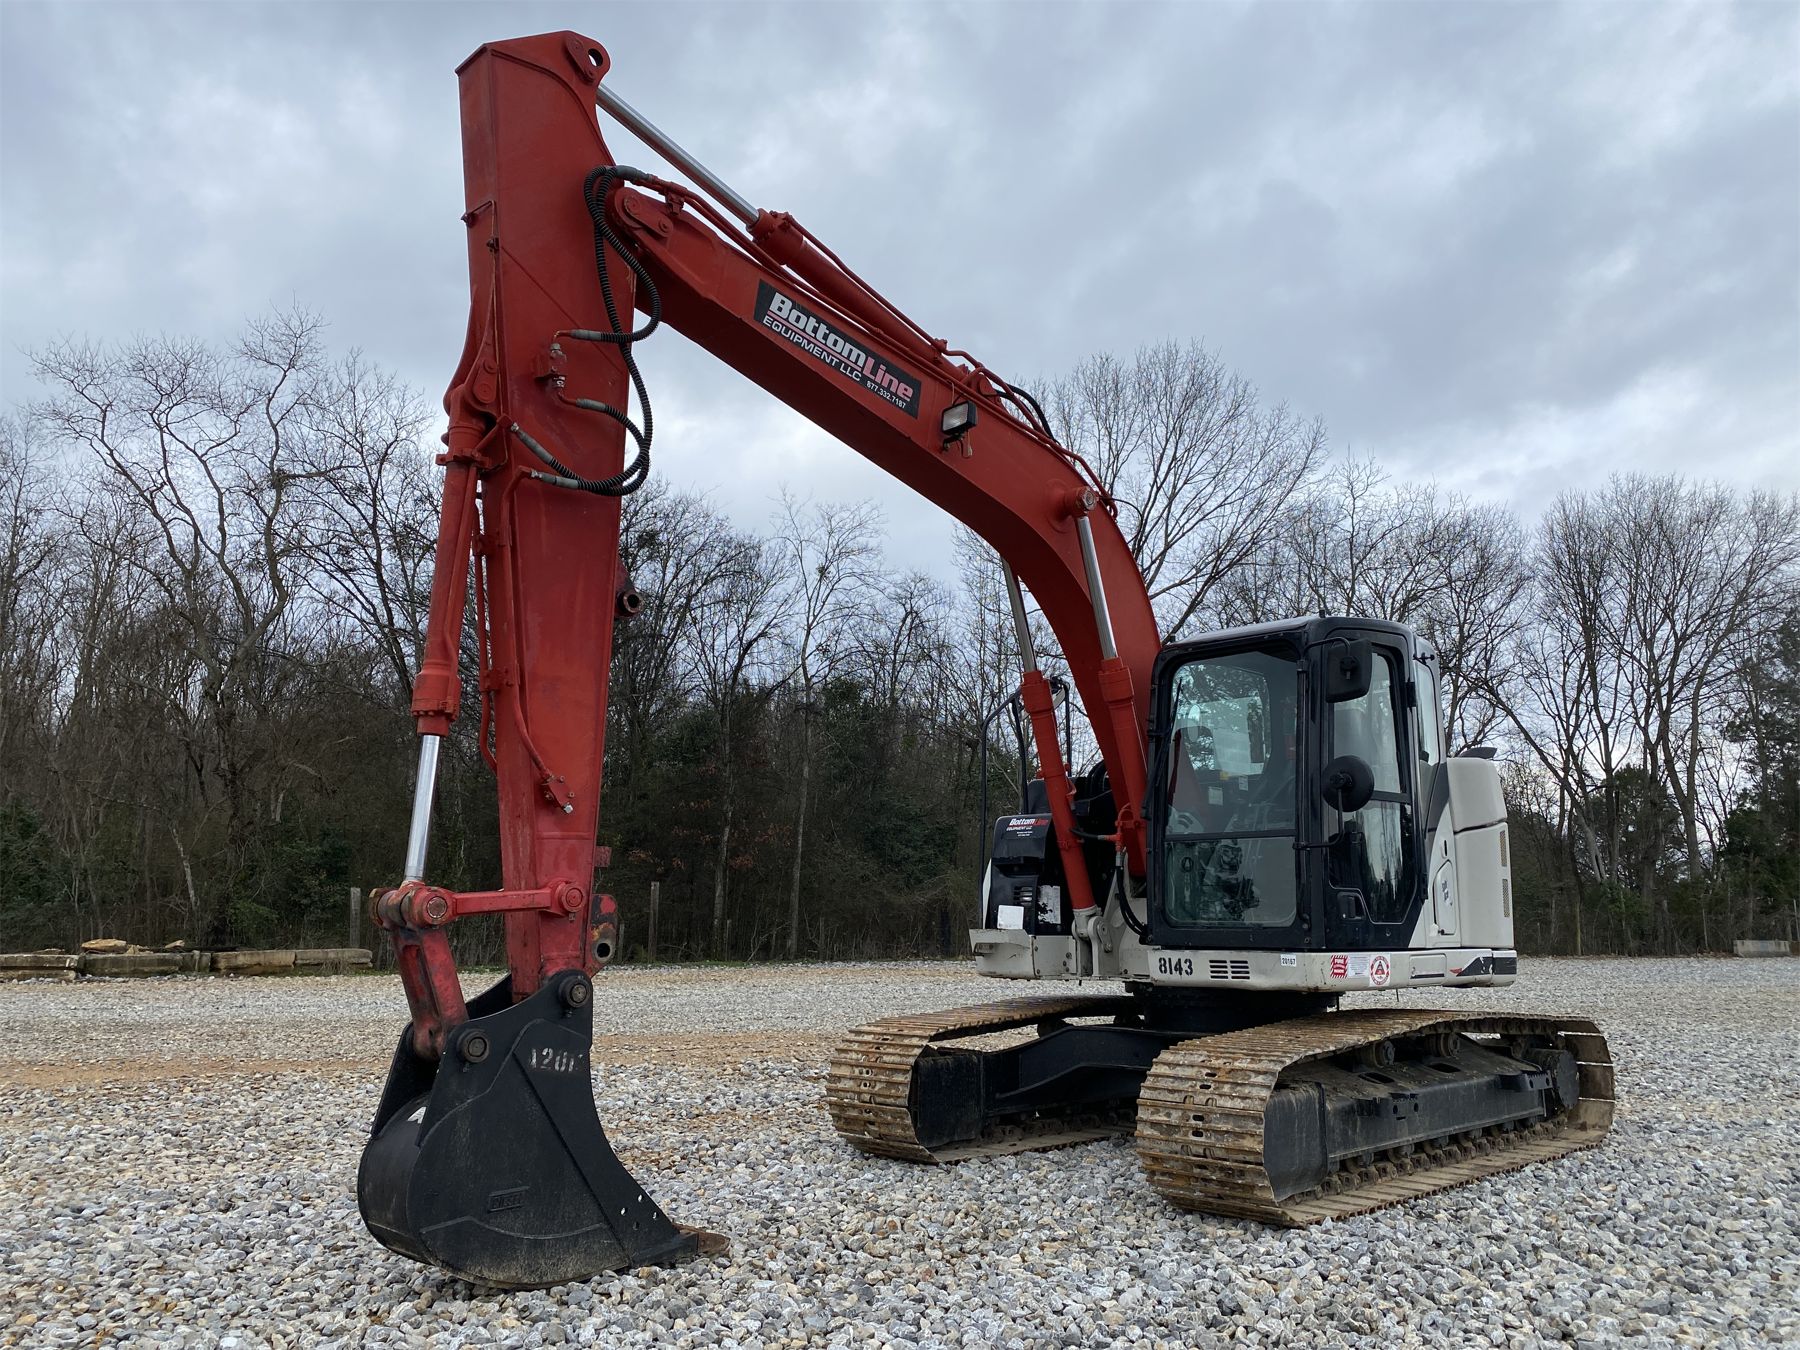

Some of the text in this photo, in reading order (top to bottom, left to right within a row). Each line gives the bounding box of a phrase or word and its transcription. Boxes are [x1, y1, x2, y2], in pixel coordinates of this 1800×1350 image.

[762, 315, 862, 382] EQUIPMENT LLC
[866, 380, 906, 409] 877.332.7187
[1158, 957, 1194, 976] 8143
